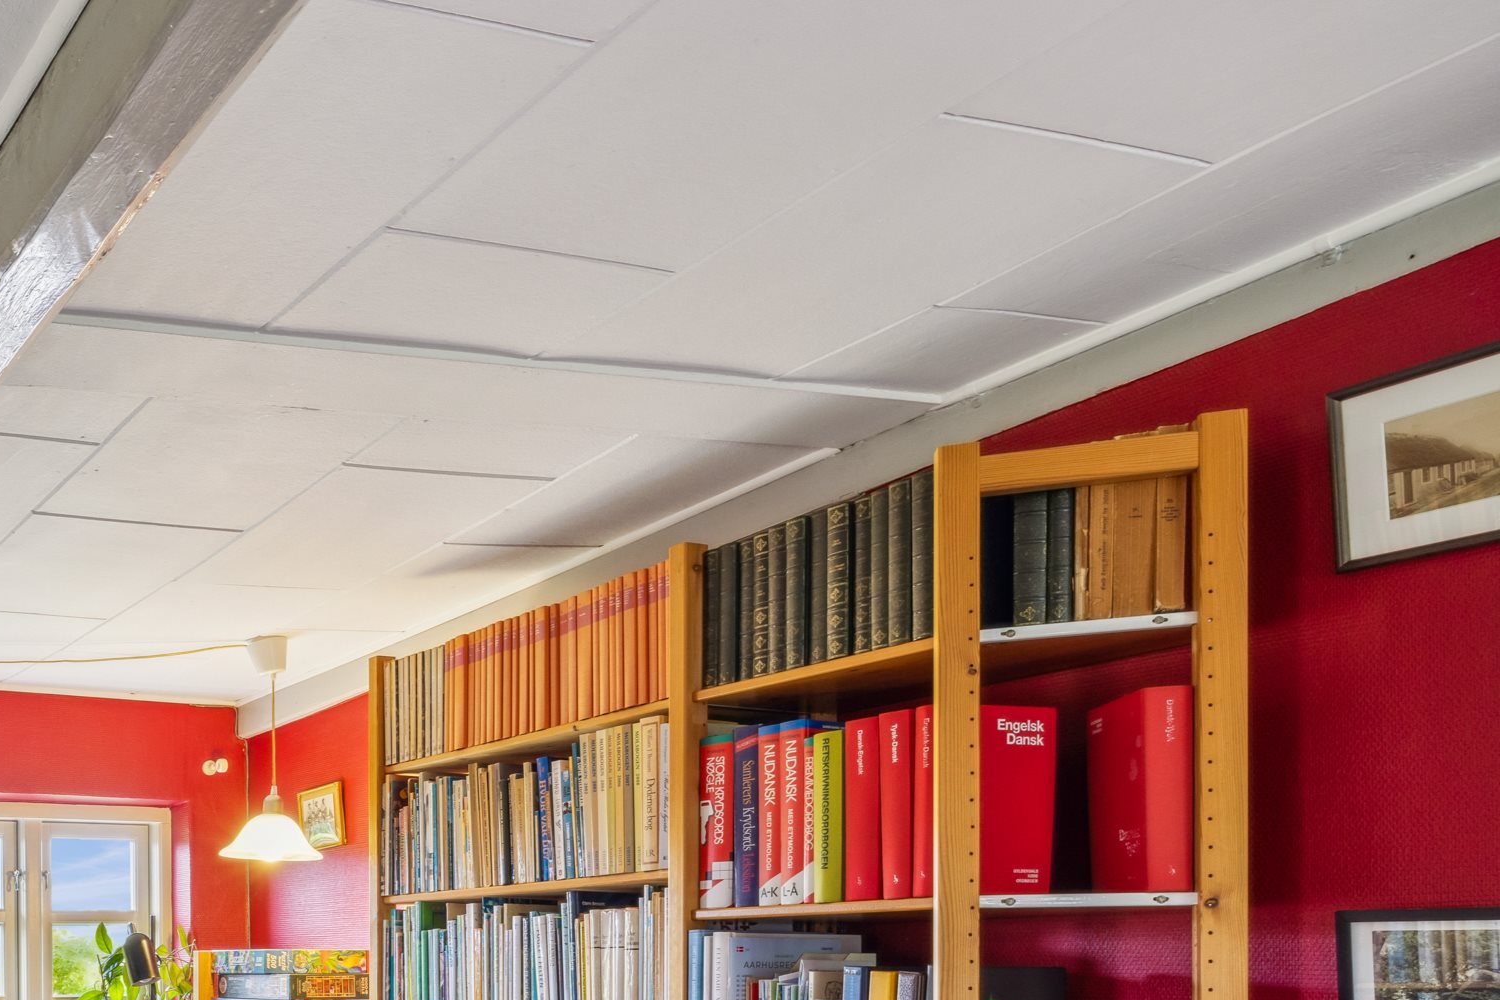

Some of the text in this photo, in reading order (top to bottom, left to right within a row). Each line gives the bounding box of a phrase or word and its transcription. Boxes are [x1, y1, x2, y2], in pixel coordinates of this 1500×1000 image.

[891, 723, 899, 764] Tysk-Dansk
[922, 717, 930, 769] Engelsk-Dansk
[997, 718, 1045, 735] Engelsk
[1006, 733, 1045, 746] Dansk
[706, 757, 714, 793] NØGLE
[764, 744, 776, 806] NUDANSK
[785, 741, 796, 804] NUDANSK
[856, 730, 864, 776] Dansk-Engelsk
[539, 780, 549, 838] HVOR VAR
[644, 779, 656, 831] Dydernes bog
[713, 756, 725, 845] STORE KRYDSORDS
[739, 760, 755, 893] Samlerens Krydsords Leksikon
[805, 756, 814, 851] FREMMEDORDBOG
[821, 738, 830, 870] RETSKRIVNINGSORDBOGEN
[761, 886, 779, 898] A-K
[783, 882, 799, 896] L-Å
